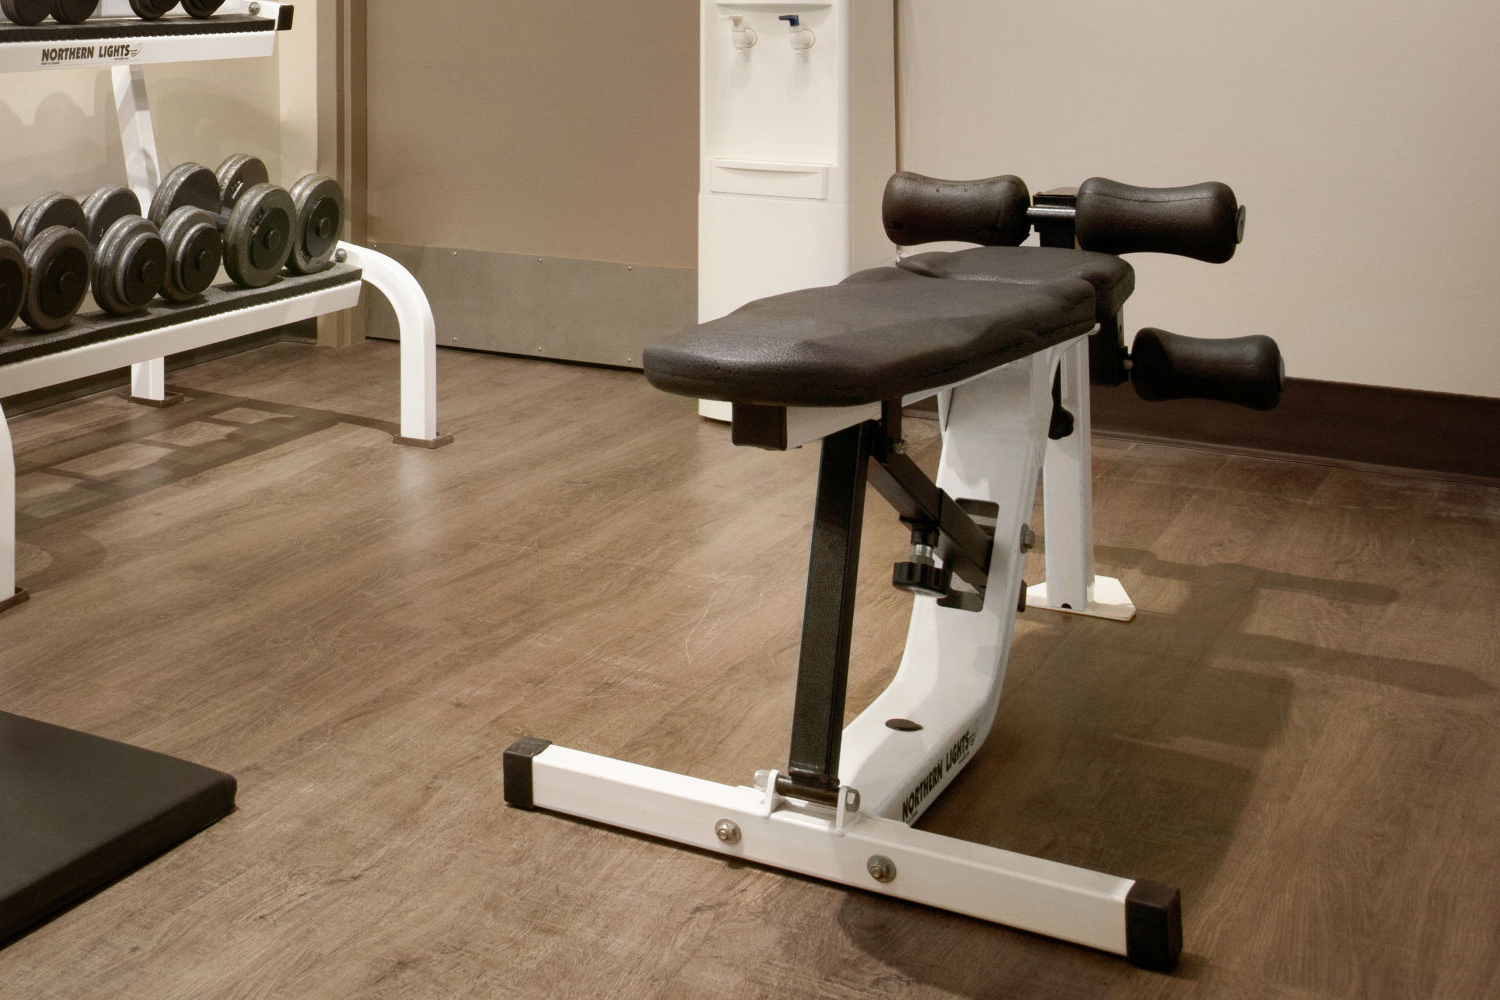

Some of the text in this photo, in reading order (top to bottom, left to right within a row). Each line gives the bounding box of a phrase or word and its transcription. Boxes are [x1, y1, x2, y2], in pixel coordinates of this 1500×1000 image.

[41, 46, 95, 62] NORTHERN
[98, 44, 131, 58] LIGHTS
[902, 729, 970, 823] NORTHERN LIGHTS
